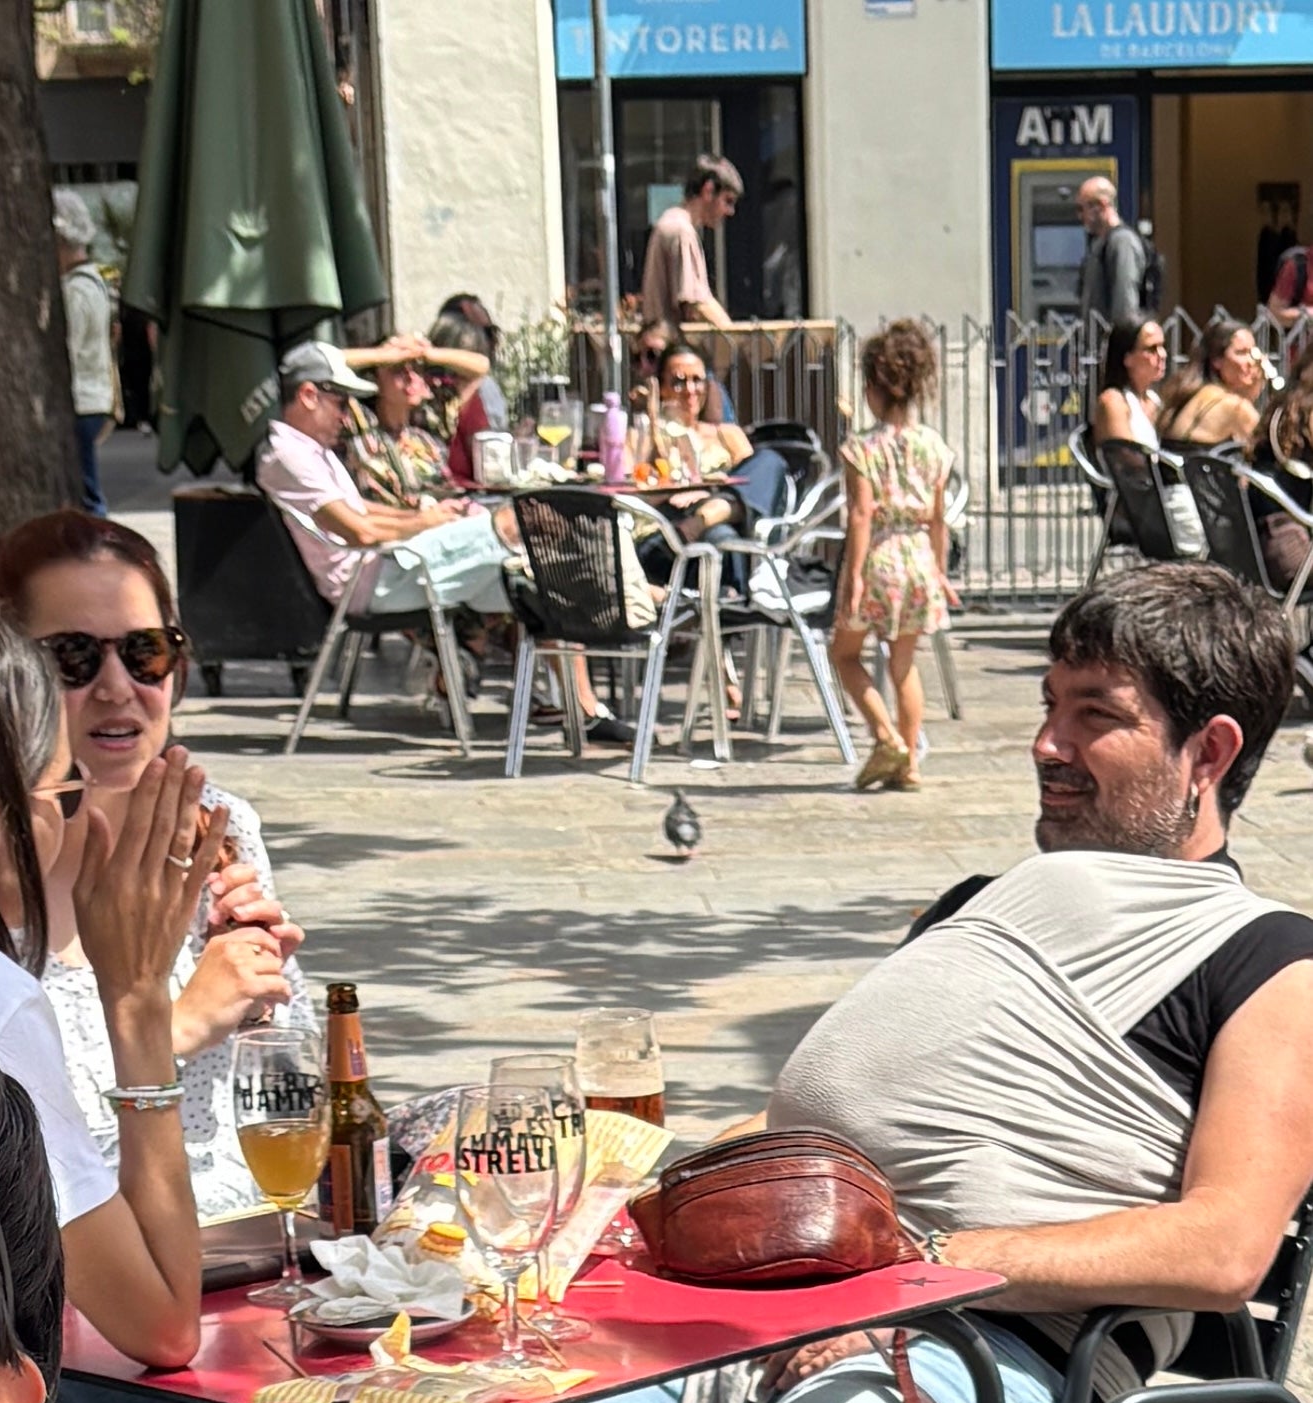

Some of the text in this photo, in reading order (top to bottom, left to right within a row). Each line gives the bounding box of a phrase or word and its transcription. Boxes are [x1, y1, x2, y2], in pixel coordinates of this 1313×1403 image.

[1052, 0, 1284, 37] LA LAUNDRY
[570, 23, 790, 54] TNTORERIA
